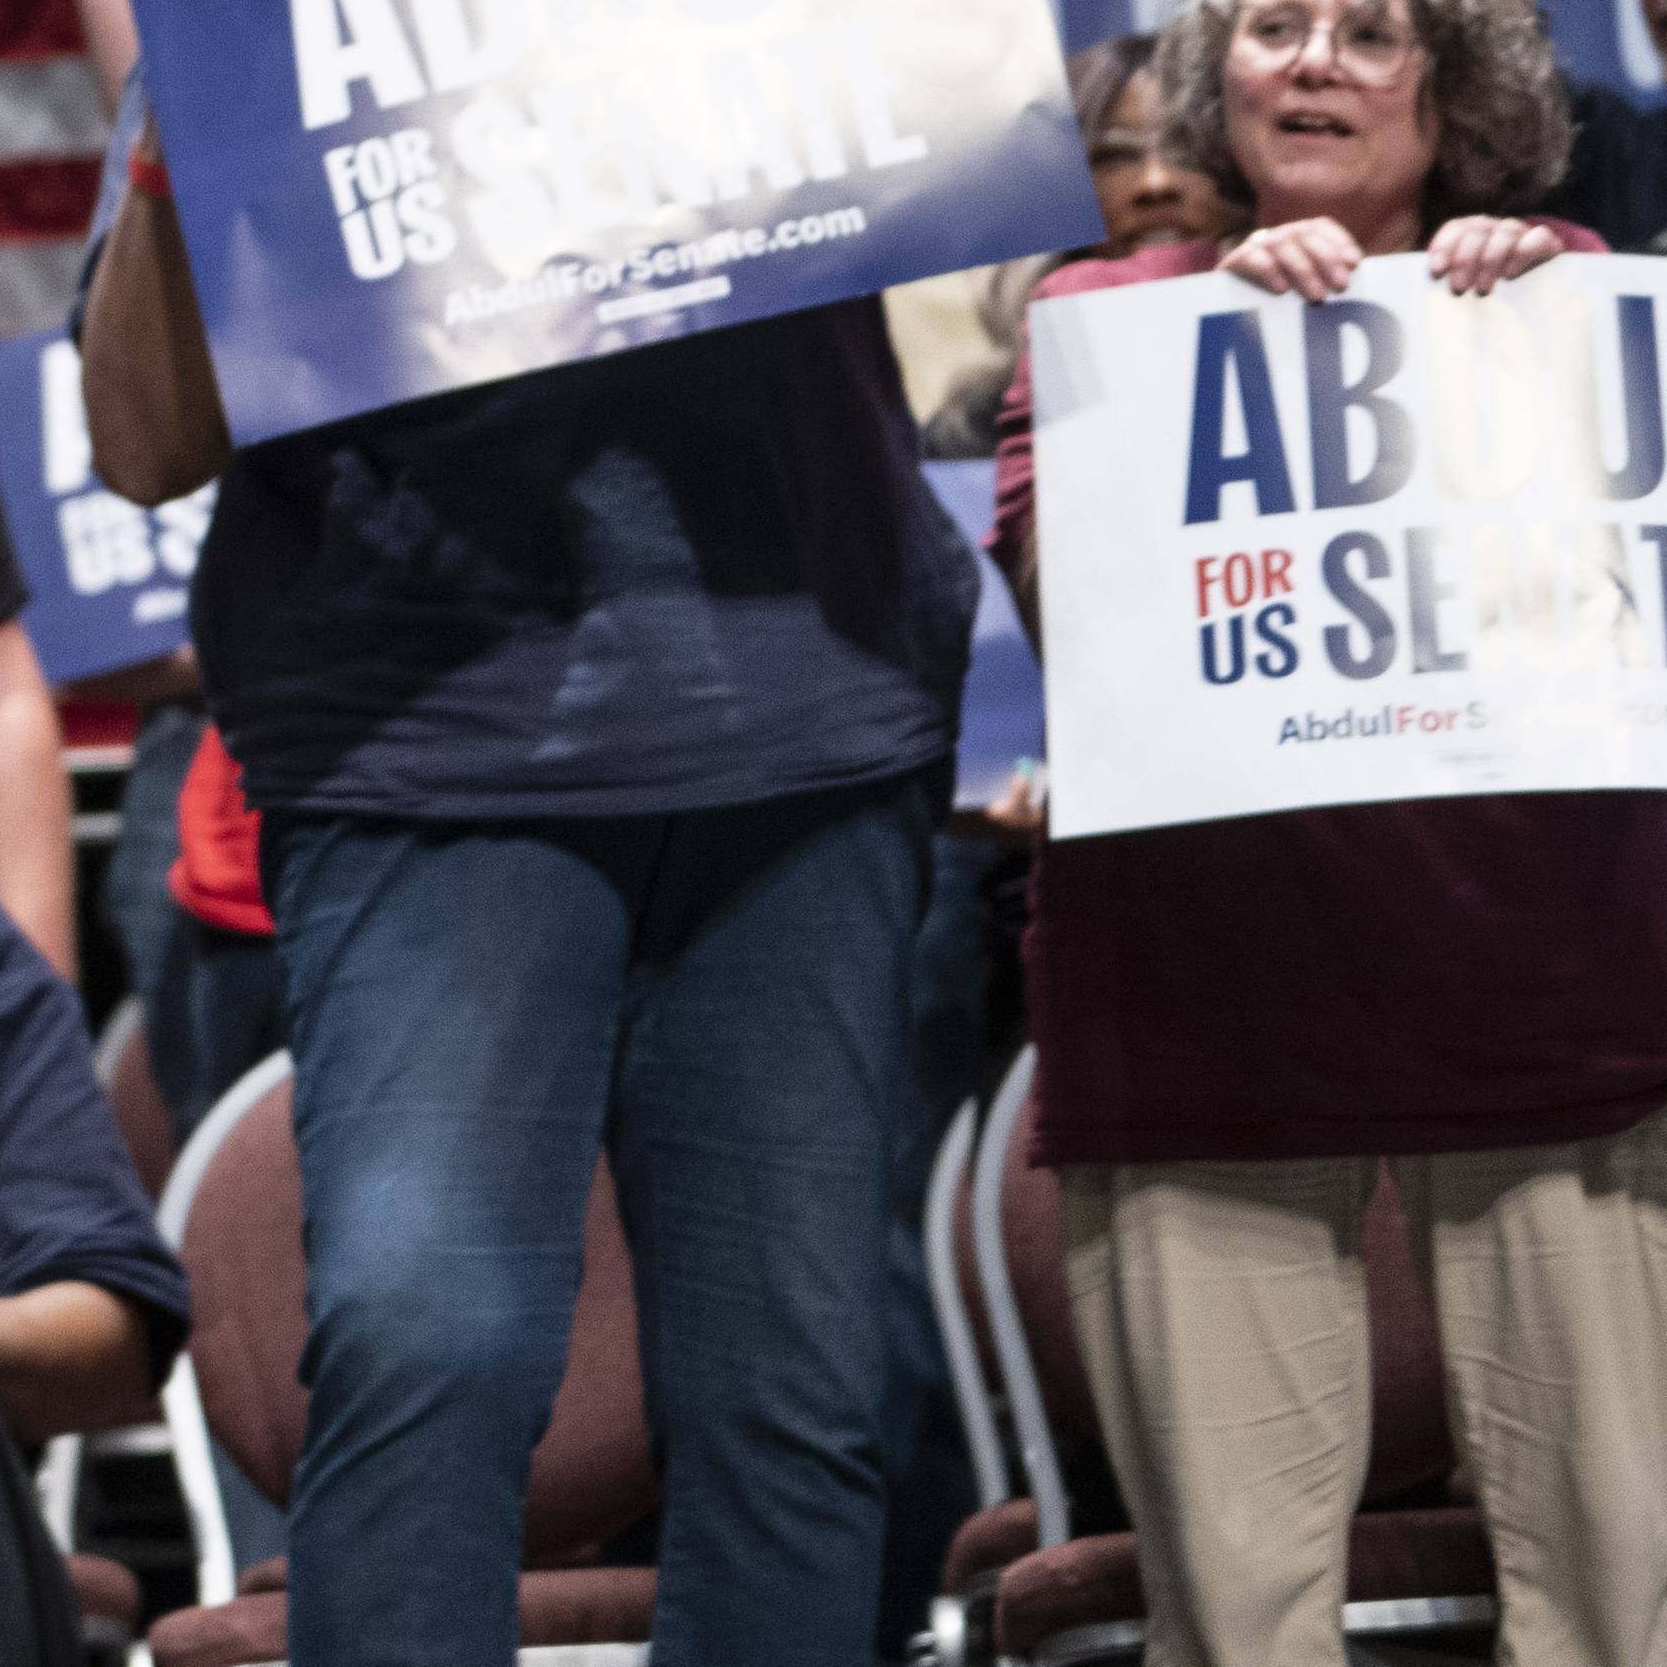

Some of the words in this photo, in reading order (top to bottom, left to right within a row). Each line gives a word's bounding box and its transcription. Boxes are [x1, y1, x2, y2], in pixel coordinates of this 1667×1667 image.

[324, 128, 438, 217] FOR
[341, 181, 457, 279] US
[443, 204, 865, 328] AbdulForSenate.com
[1193, 547, 1297, 620] FOR
[1197, 599, 1302, 686] US
